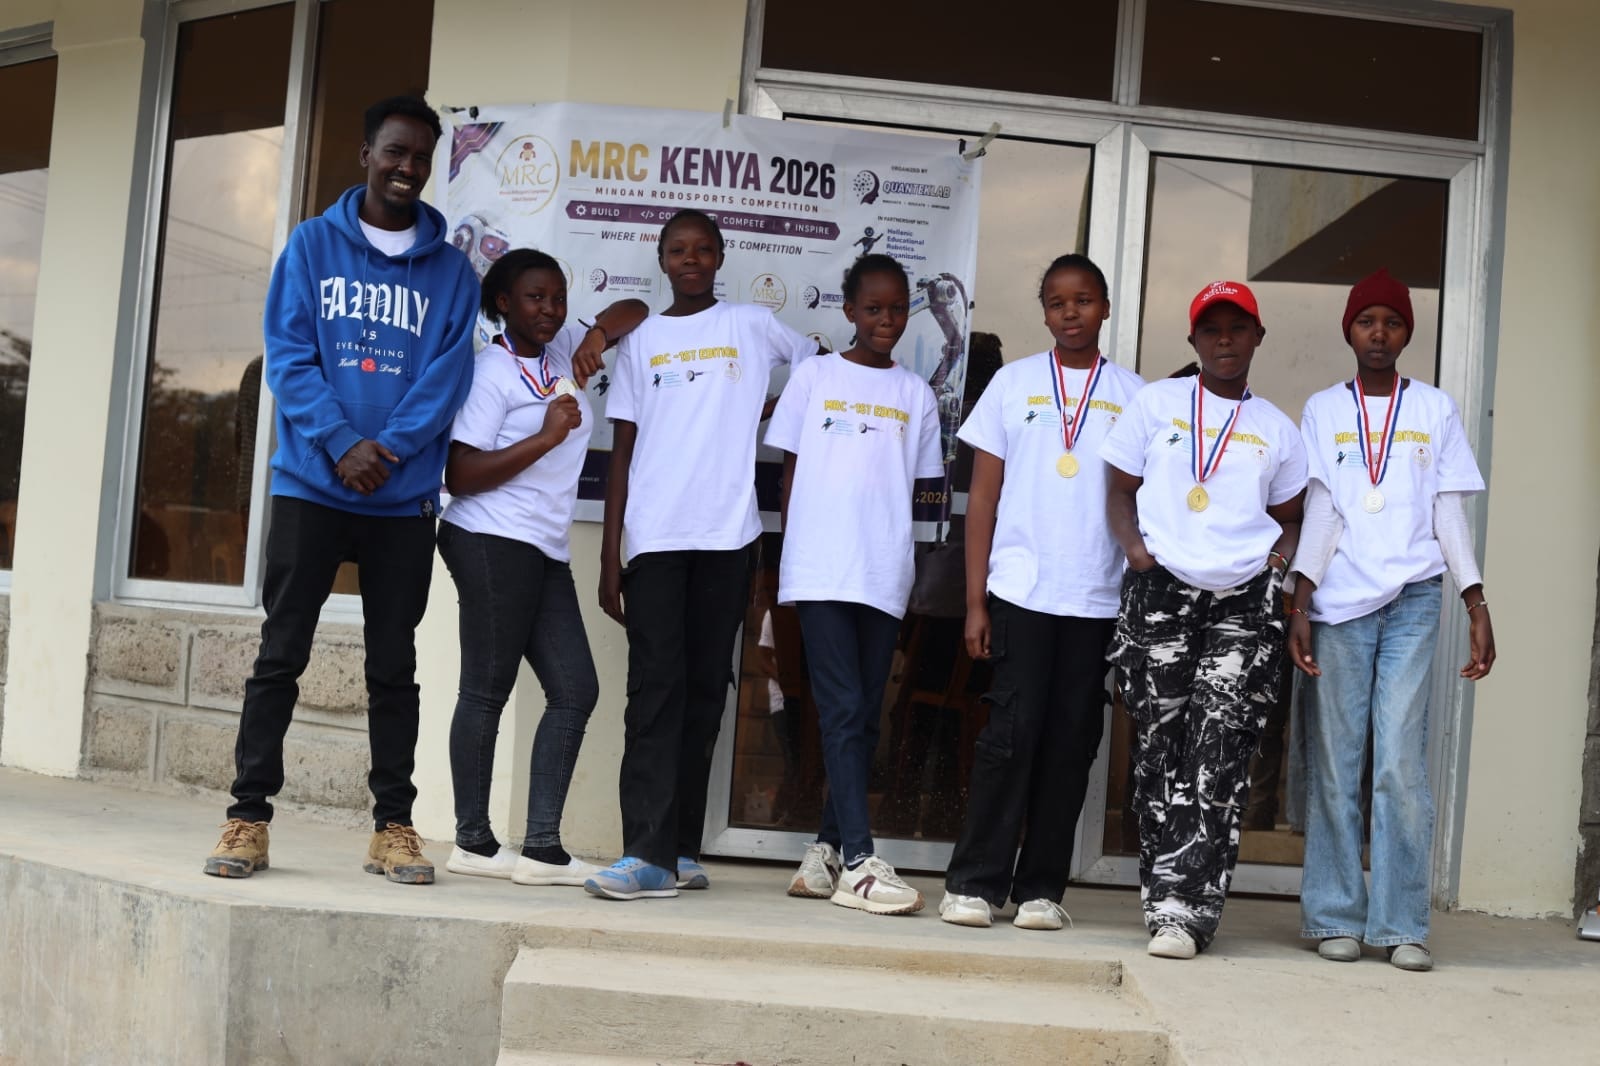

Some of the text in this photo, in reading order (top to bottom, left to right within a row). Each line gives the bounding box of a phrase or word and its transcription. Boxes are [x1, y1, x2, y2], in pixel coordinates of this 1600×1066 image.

[500, 163, 552, 187] MRC
[569, 140, 836, 200] MRC KENYA 2026
[883, 181, 952, 199] QUANTEKLAB
[595, 187, 819, 214] MINOAN ROBOSPORTS COMPETITION
[591, 207, 621, 218] BUILD
[722, 216, 766, 229] COMPETE
[600, 230, 636, 242] WHERE
[795, 223, 830, 236] INSPIRE
[887, 228, 913, 237] Hellenic
[887, 235, 925, 246] Educational
[739, 240, 803, 256] COMPETITION
[886, 243, 915, 252] Robotics
[886, 251, 928, 261] Organization
[753, 287, 785, 300] MRC
[319, 276, 430, 338] FAMILY
[362, 329, 377, 340] IS
[336, 341, 405, 359] EVERYTHING
[379, 363, 402, 376] Daily
[824, 399, 848, 412] MRC
[1027, 395, 1052, 406] MRC
[1334, 431, 1358, 445] MRC
[1394, 430, 1431, 445] DITION
[919, 490, 949, 504] 2026
